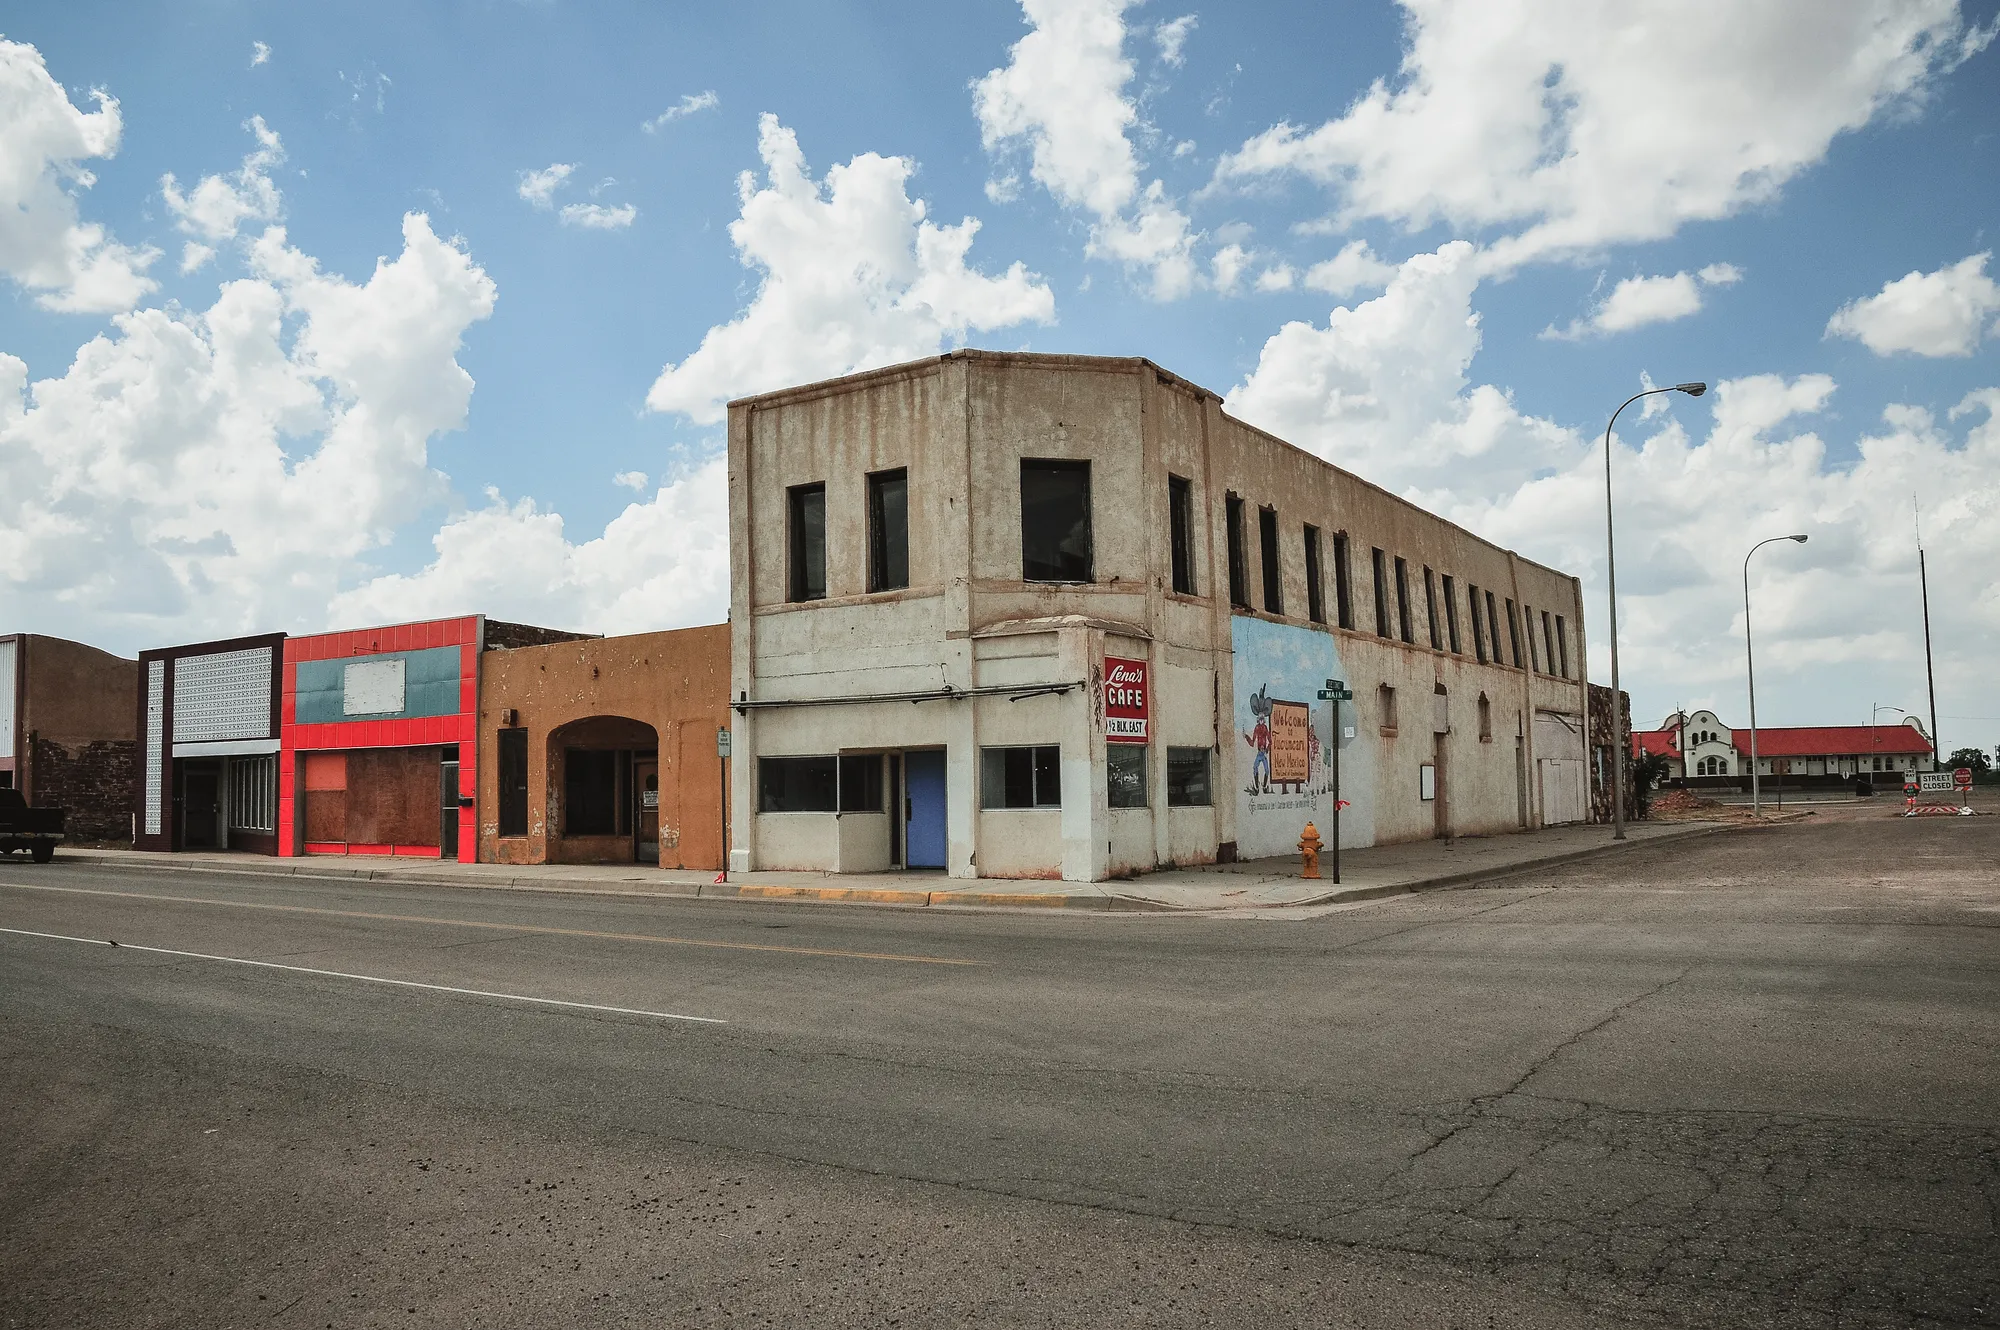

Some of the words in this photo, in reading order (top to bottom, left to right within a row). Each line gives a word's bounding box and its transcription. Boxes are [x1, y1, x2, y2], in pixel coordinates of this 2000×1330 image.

[1105, 665, 1142, 687] Lena's
[1108, 687, 1142, 707] CAFE
[1326, 691, 1343, 699] MAIN
[1273, 709, 1306, 727] Welcome
[1129, 721, 1142, 733] EAST
[1274, 753, 1285, 768] New
[1923, 782, 1951, 790] CLOSED
